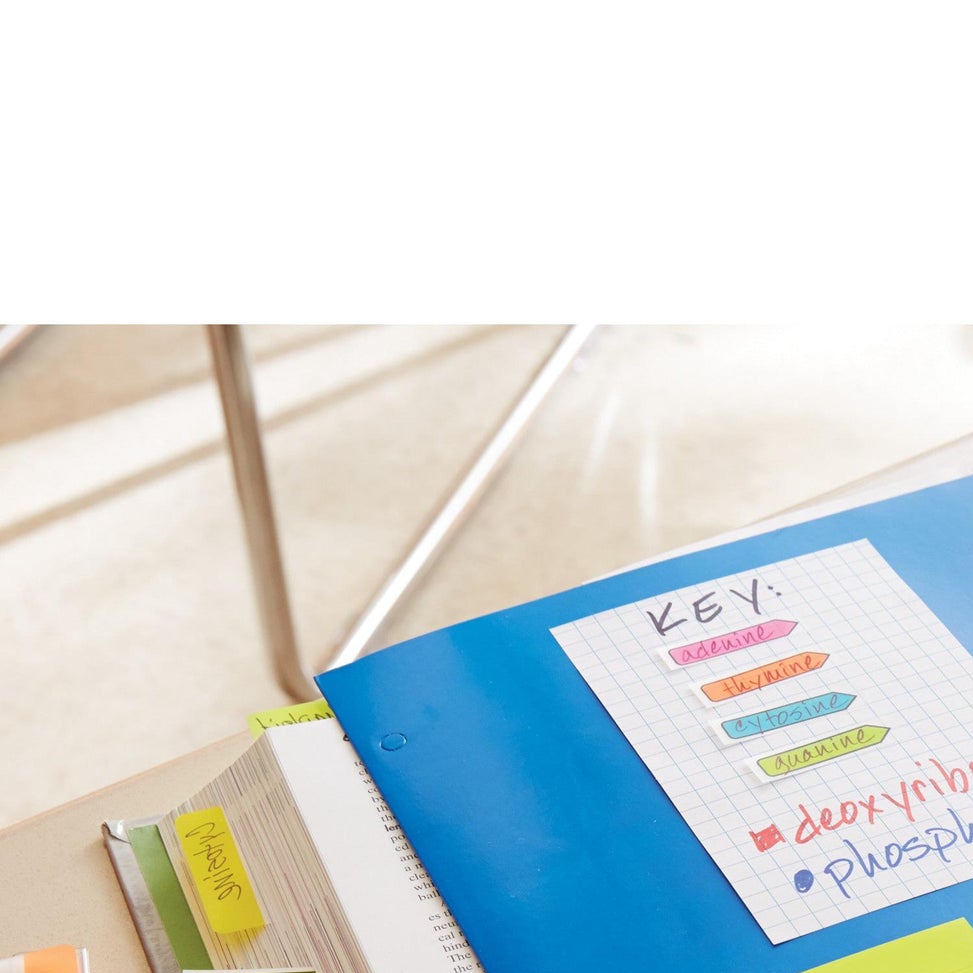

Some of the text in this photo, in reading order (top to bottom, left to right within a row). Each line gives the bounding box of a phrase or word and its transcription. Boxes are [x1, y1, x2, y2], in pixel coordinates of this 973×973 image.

[646, 579, 783, 636] KEY:
[681, 623, 774, 663] adenine
[723, 651, 820, 697] thymine
[735, 692, 840, 734] cytosine
[774, 728, 867, 775] guanine
[447, 951, 472, 964] The
